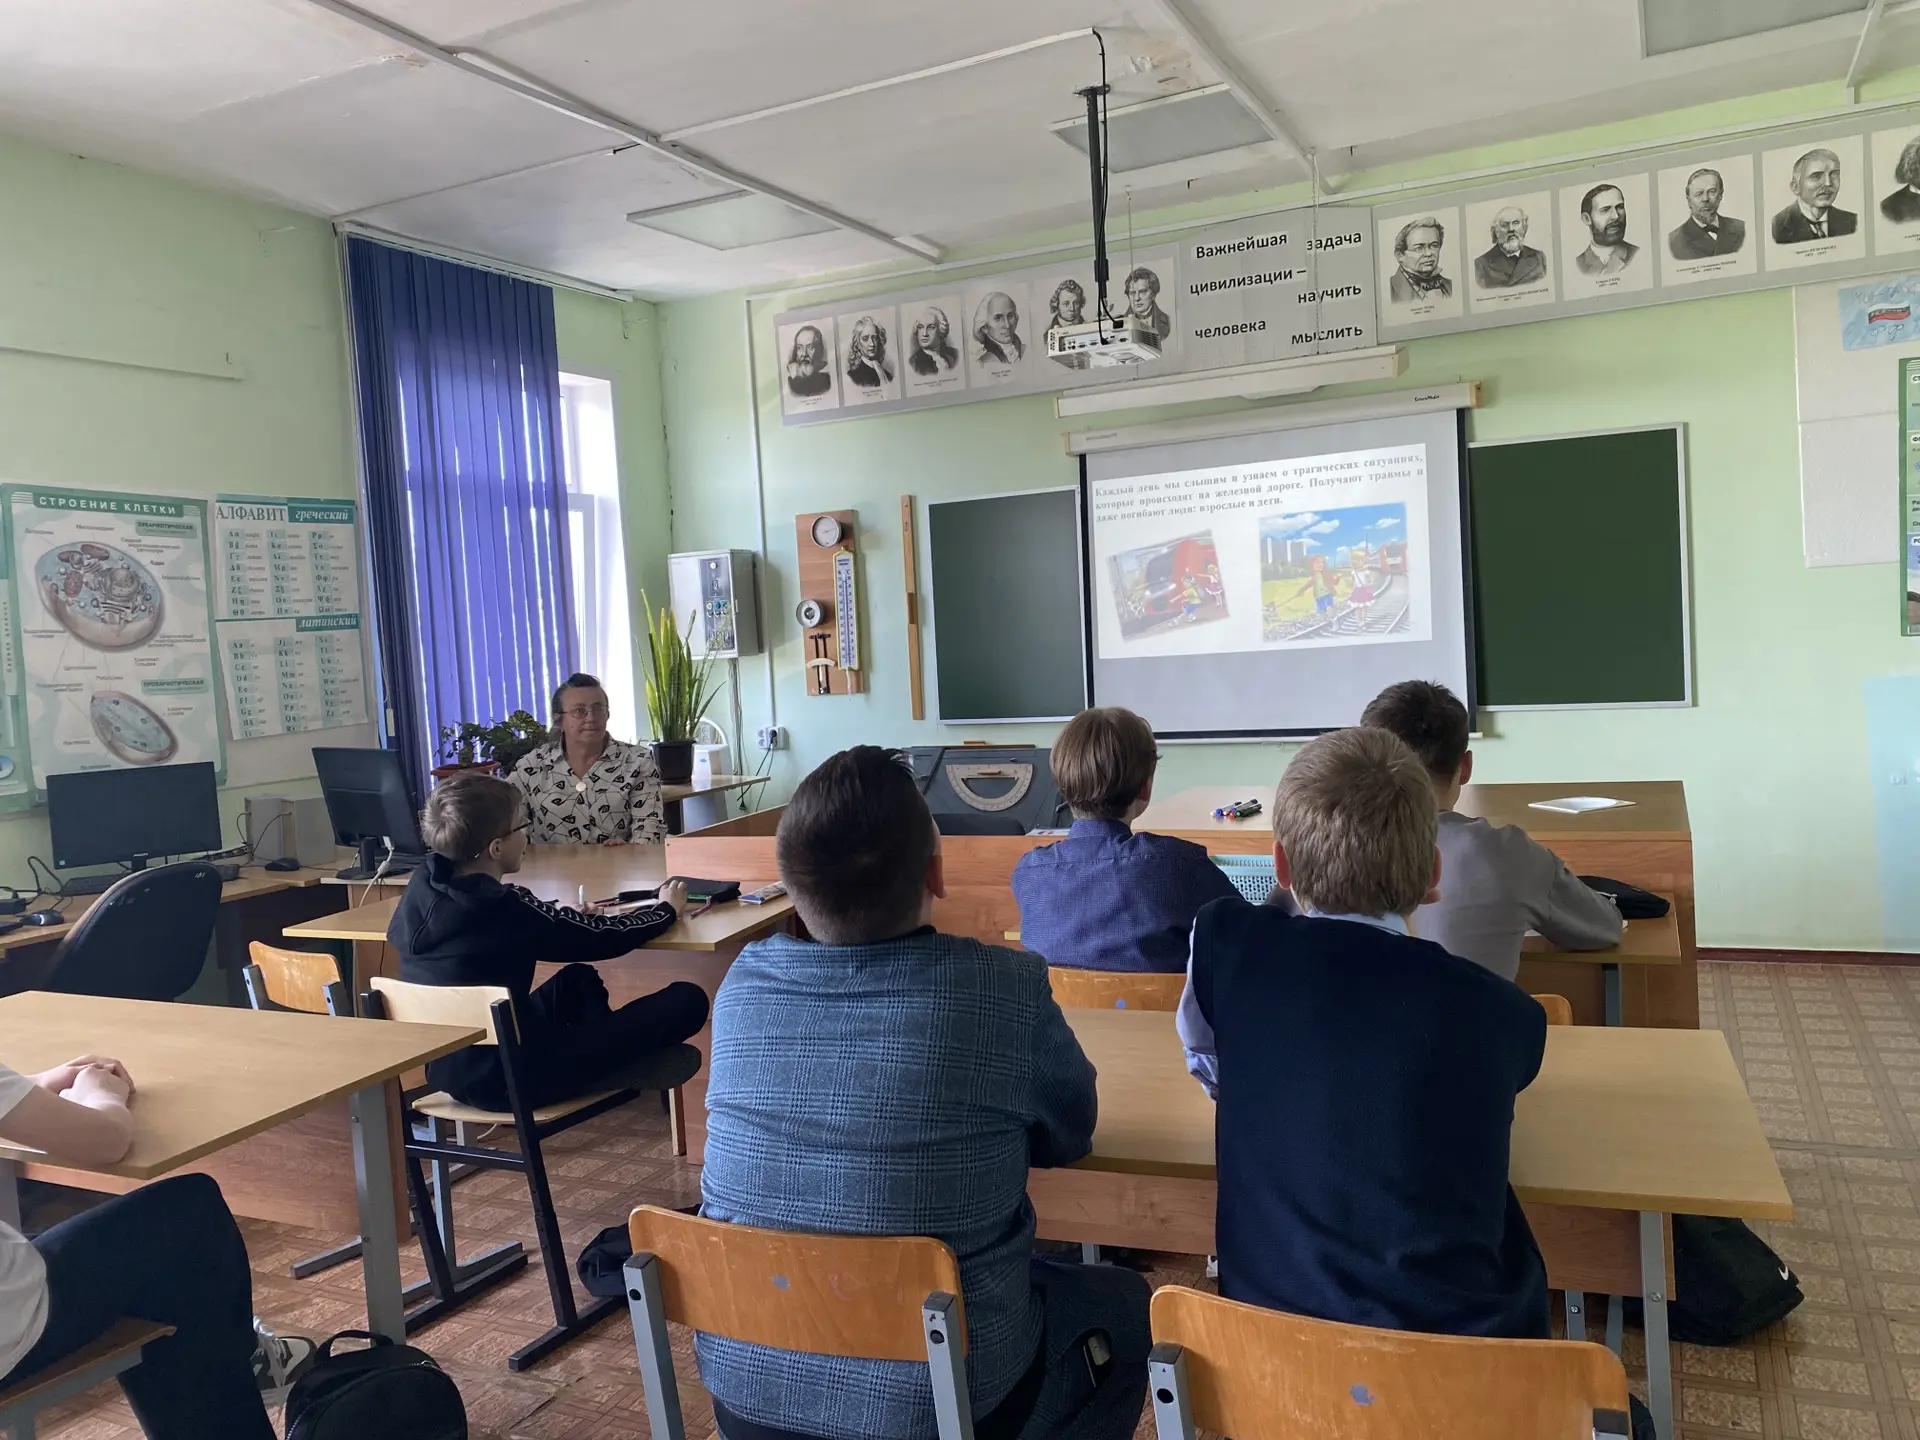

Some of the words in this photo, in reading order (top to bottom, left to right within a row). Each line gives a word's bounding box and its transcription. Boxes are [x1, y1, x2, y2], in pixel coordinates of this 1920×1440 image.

[1196, 233, 1288, 259] Важнейшая
[1306, 232, 1362, 251] задача
[1190, 268, 1293, 296] цивилизации
[1298, 284, 1362, 304] научить
[1194, 320, 1267, 339] человека
[1291, 325, 1363, 345] мыслить
[1095, 486, 1134, 497] Каждый
[1138, 484, 1160, 493] день
[1164, 481, 1180, 490] мы
[1184, 476, 1227, 488] слышим
[1231, 475, 1238, 483] и
[1243, 471, 1277, 485] узнаем
[1282, 469, 1289, 477] о
[1292, 462, 1359, 477] трагических
[1095, 500, 1135, 511] которые
[1139, 493, 1193, 508] происходят
[1198, 491, 1211, 500] на
[1215, 485, 1262, 499] железной
[1266, 481, 1304, 494] дороге.
[1309, 474, 1365, 489] Получают
[1369, 469, 1411, 482] травмы
[1417, 467, 1424, 476] и
[39, 496, 118, 511] СТРОЕНИЕ
[124, 503, 177, 515] КЛЕТКИ
[216, 505, 287, 521] АЛФАВИТ
[295, 509, 349, 521] греческий
[1095, 512, 1118, 523] даже
[1120, 508, 1166, 521] погибают
[1199, 501, 1247, 515] взрослые
[1257, 496, 1284, 509] дети.
[299, 613, 357, 628] латинский
